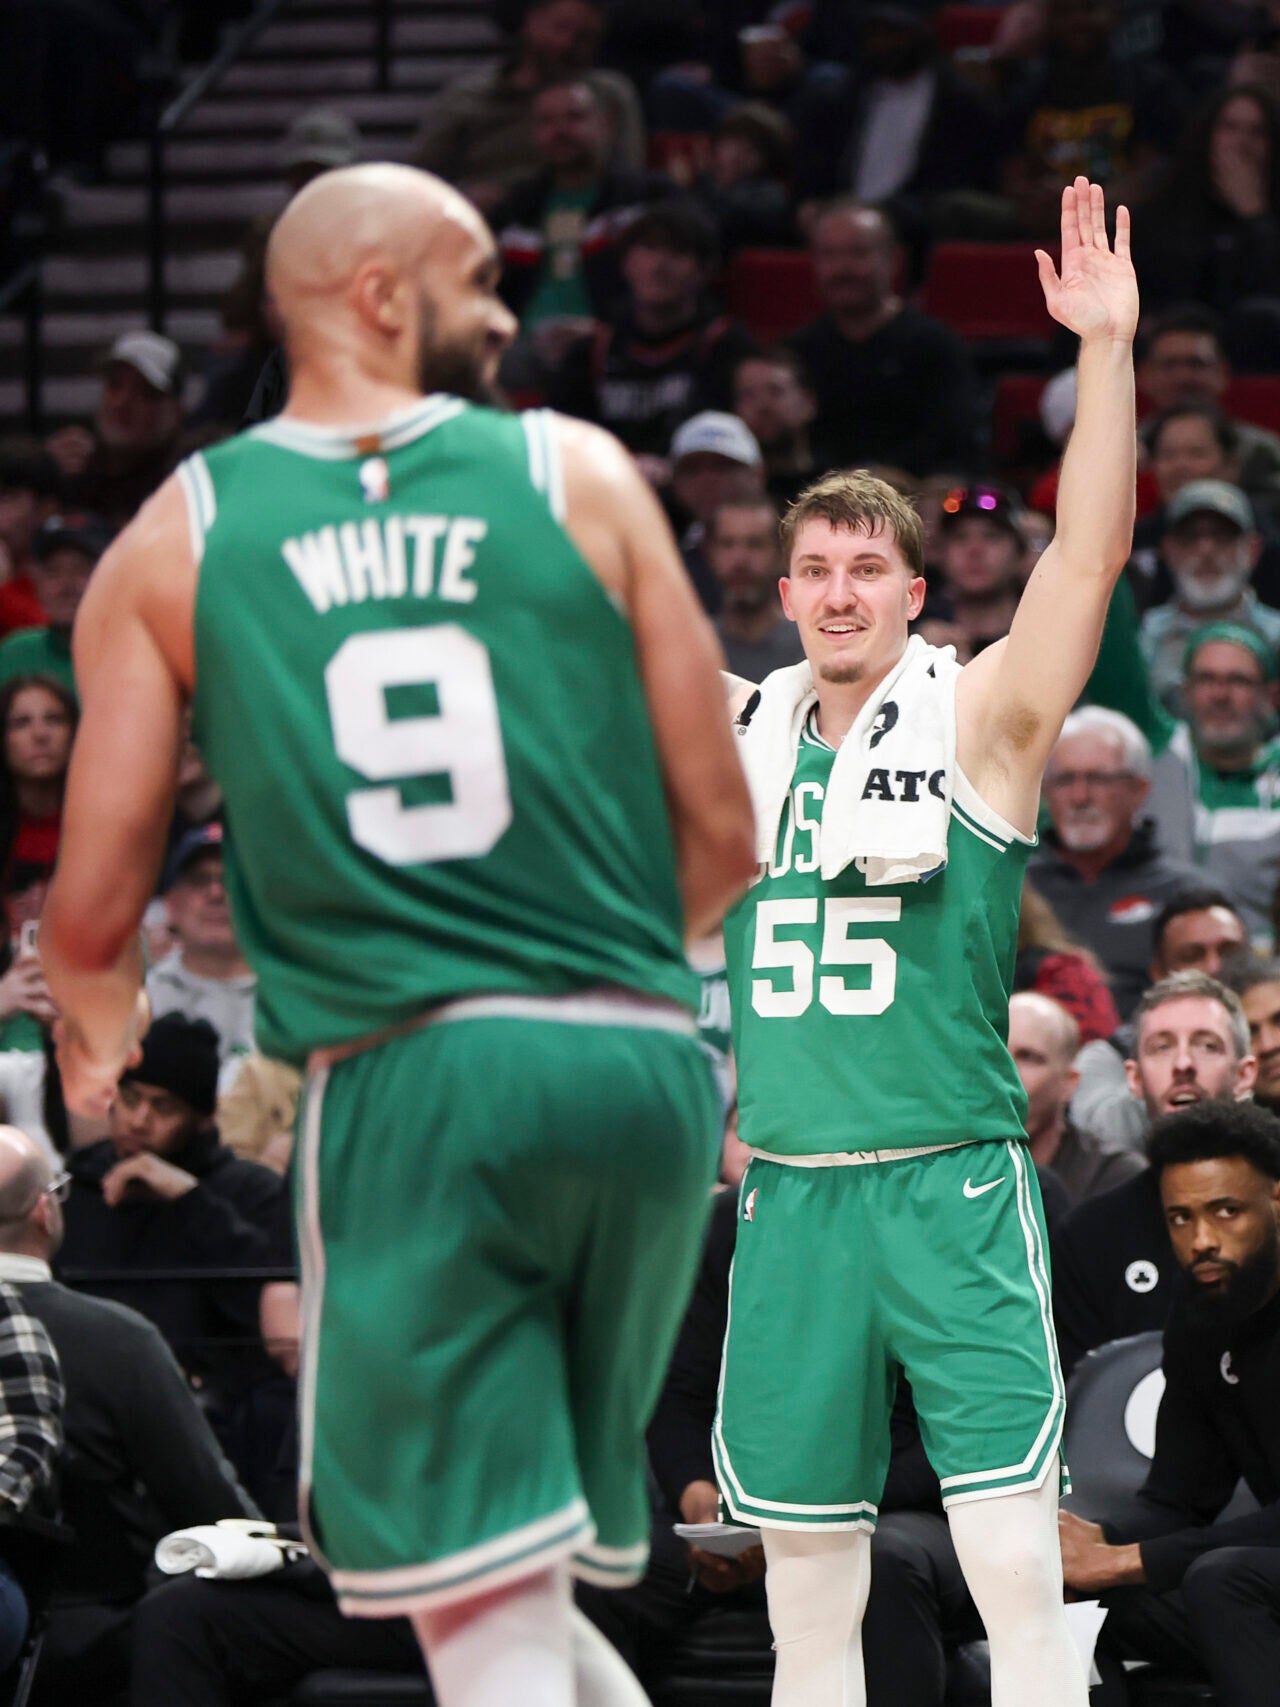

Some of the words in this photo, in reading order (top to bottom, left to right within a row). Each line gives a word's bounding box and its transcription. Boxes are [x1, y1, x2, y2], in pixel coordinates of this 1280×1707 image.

[281, 513, 487, 615] WHITE
[323, 621, 514, 868] 9
[751, 896, 902, 1018] 55
